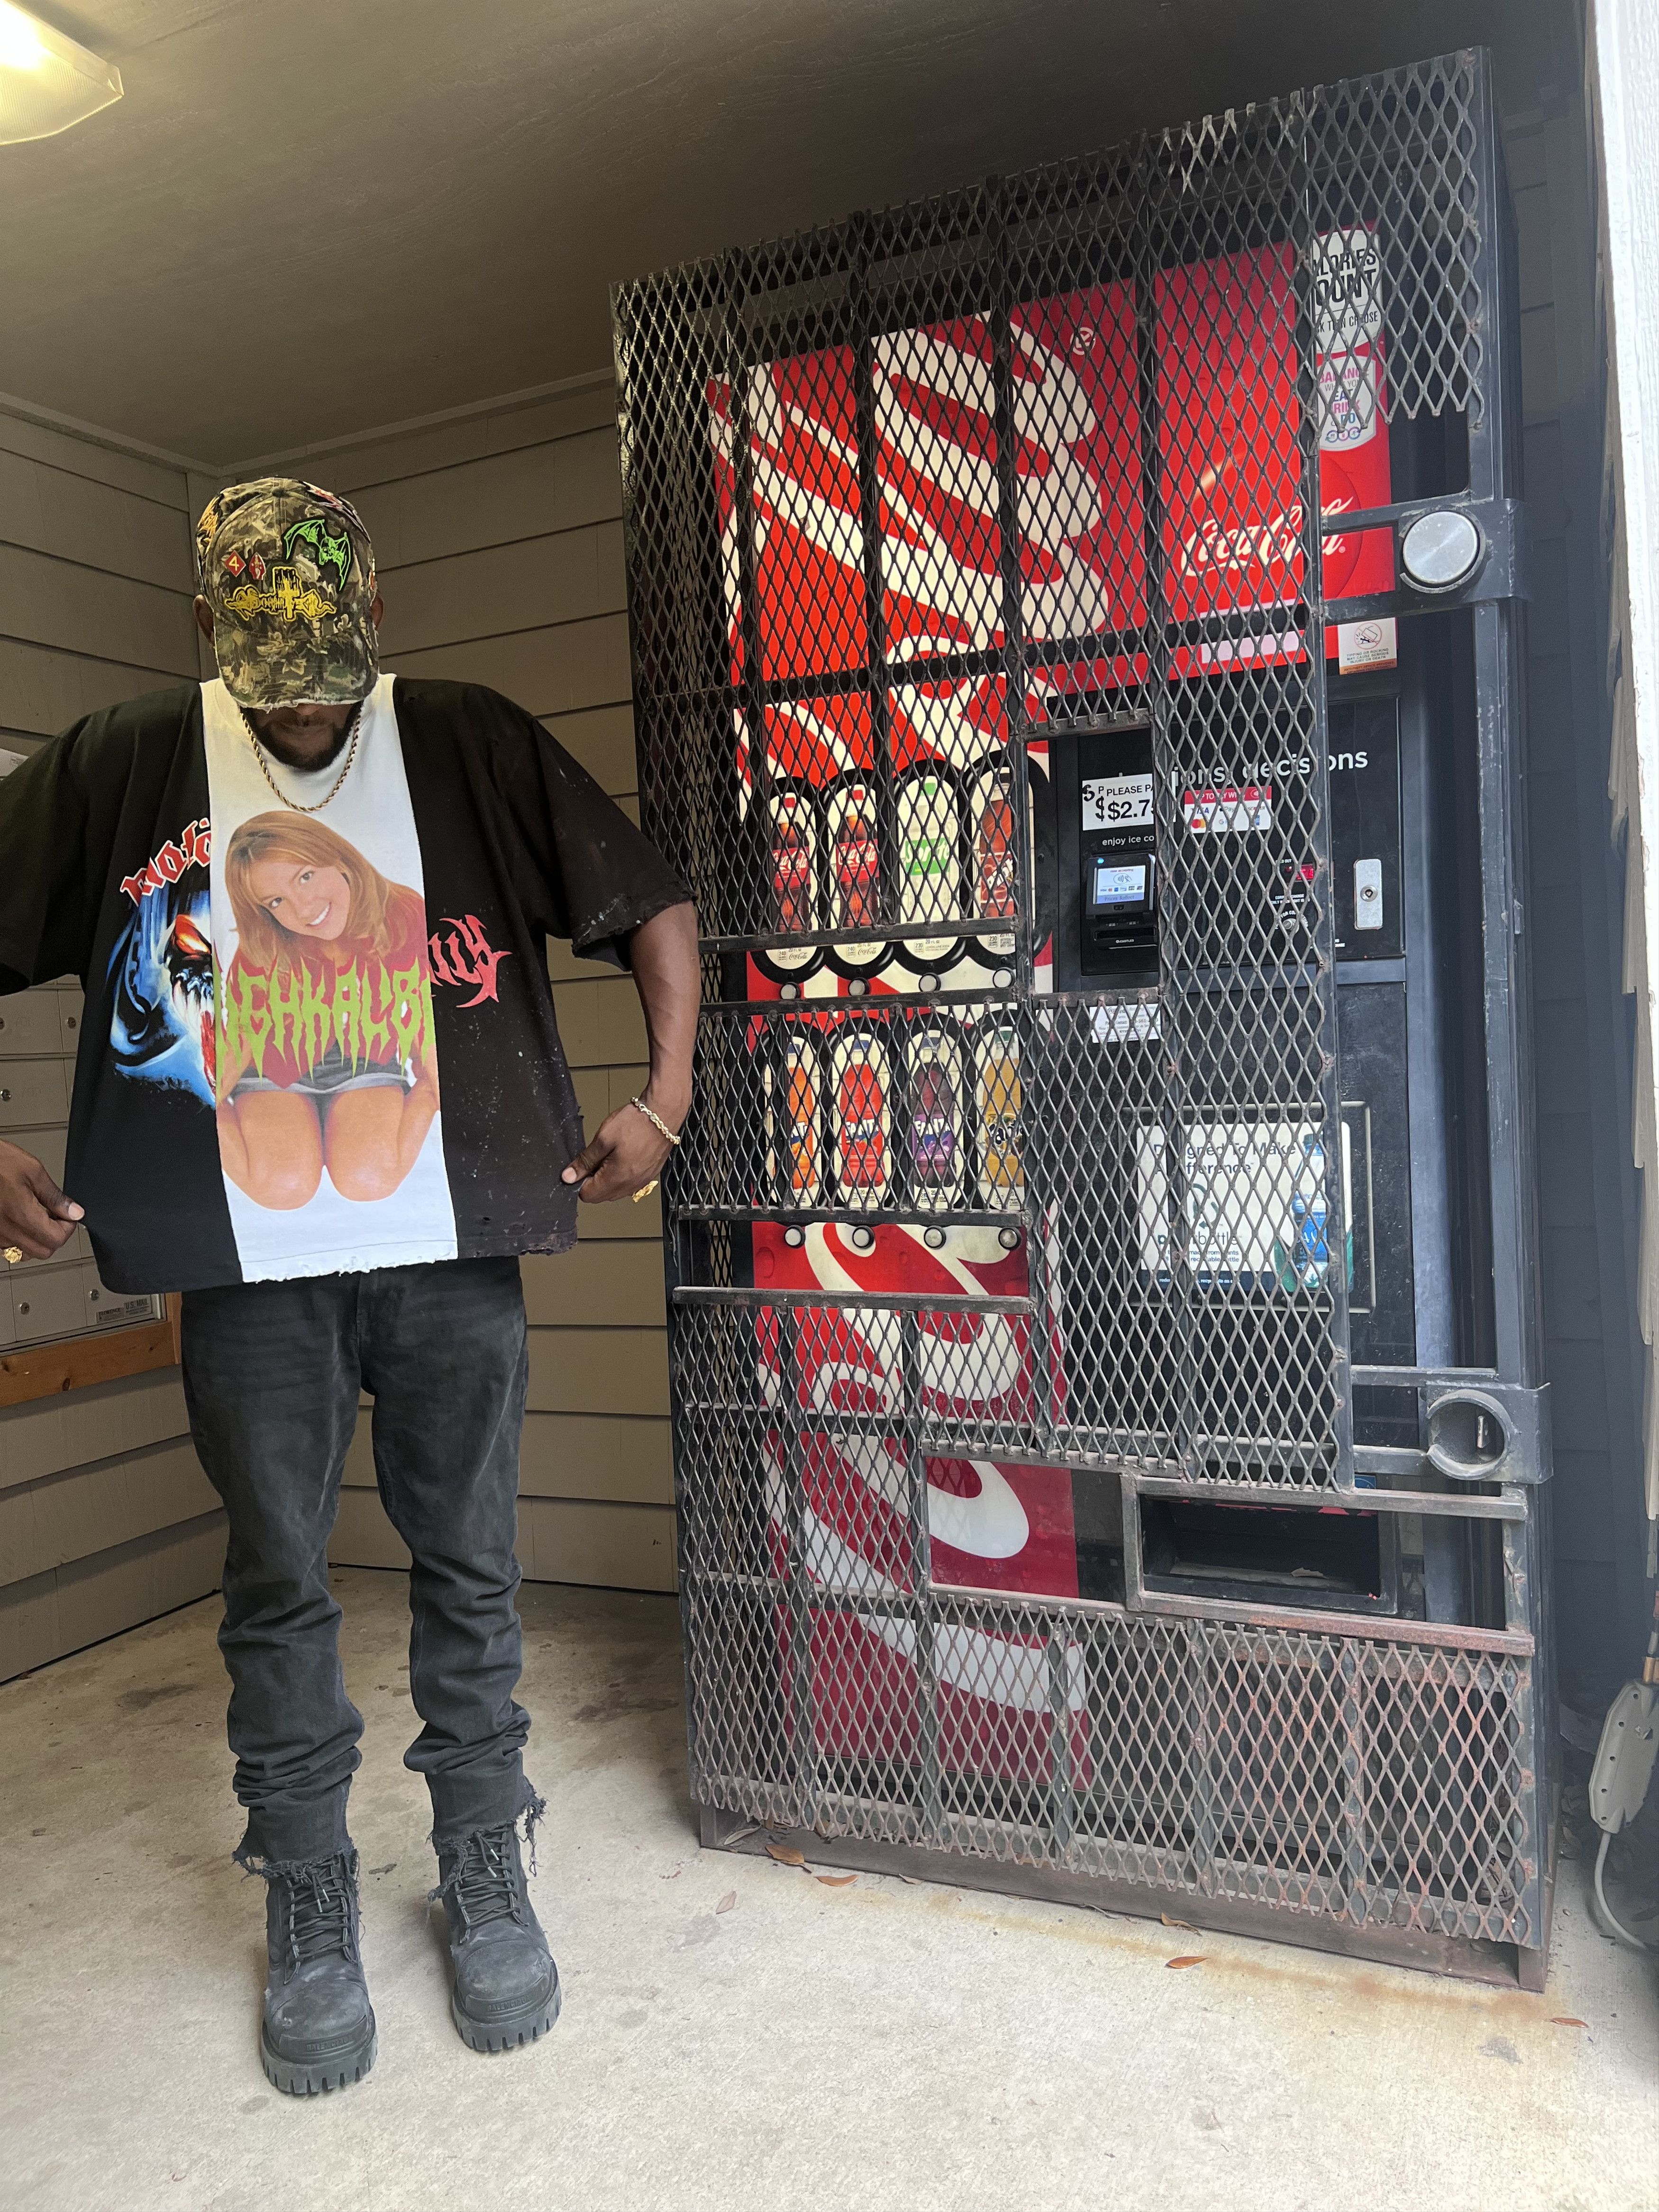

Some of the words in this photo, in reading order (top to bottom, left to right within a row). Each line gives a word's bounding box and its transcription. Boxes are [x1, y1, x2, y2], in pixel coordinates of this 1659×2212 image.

[1313, 248, 1376, 276] LORIES
[1316, 268, 1376, 306] OUNT
[1349, 311, 1378, 327] CHOSE
[1181, 497, 1354, 576] Coca-Coa
[229, 558, 240, 572] 4
[1242, 751, 1368, 780] decisons
[1107, 785, 1143, 797] PLEASE
[1107, 799, 1154, 822] $2.7
[1102, 836, 1126, 847] enjoy
[1128, 835, 1141, 843] ice
[1154, 1142, 1224, 1159] Dgned
[1185, 1161, 1252, 1174] fference
